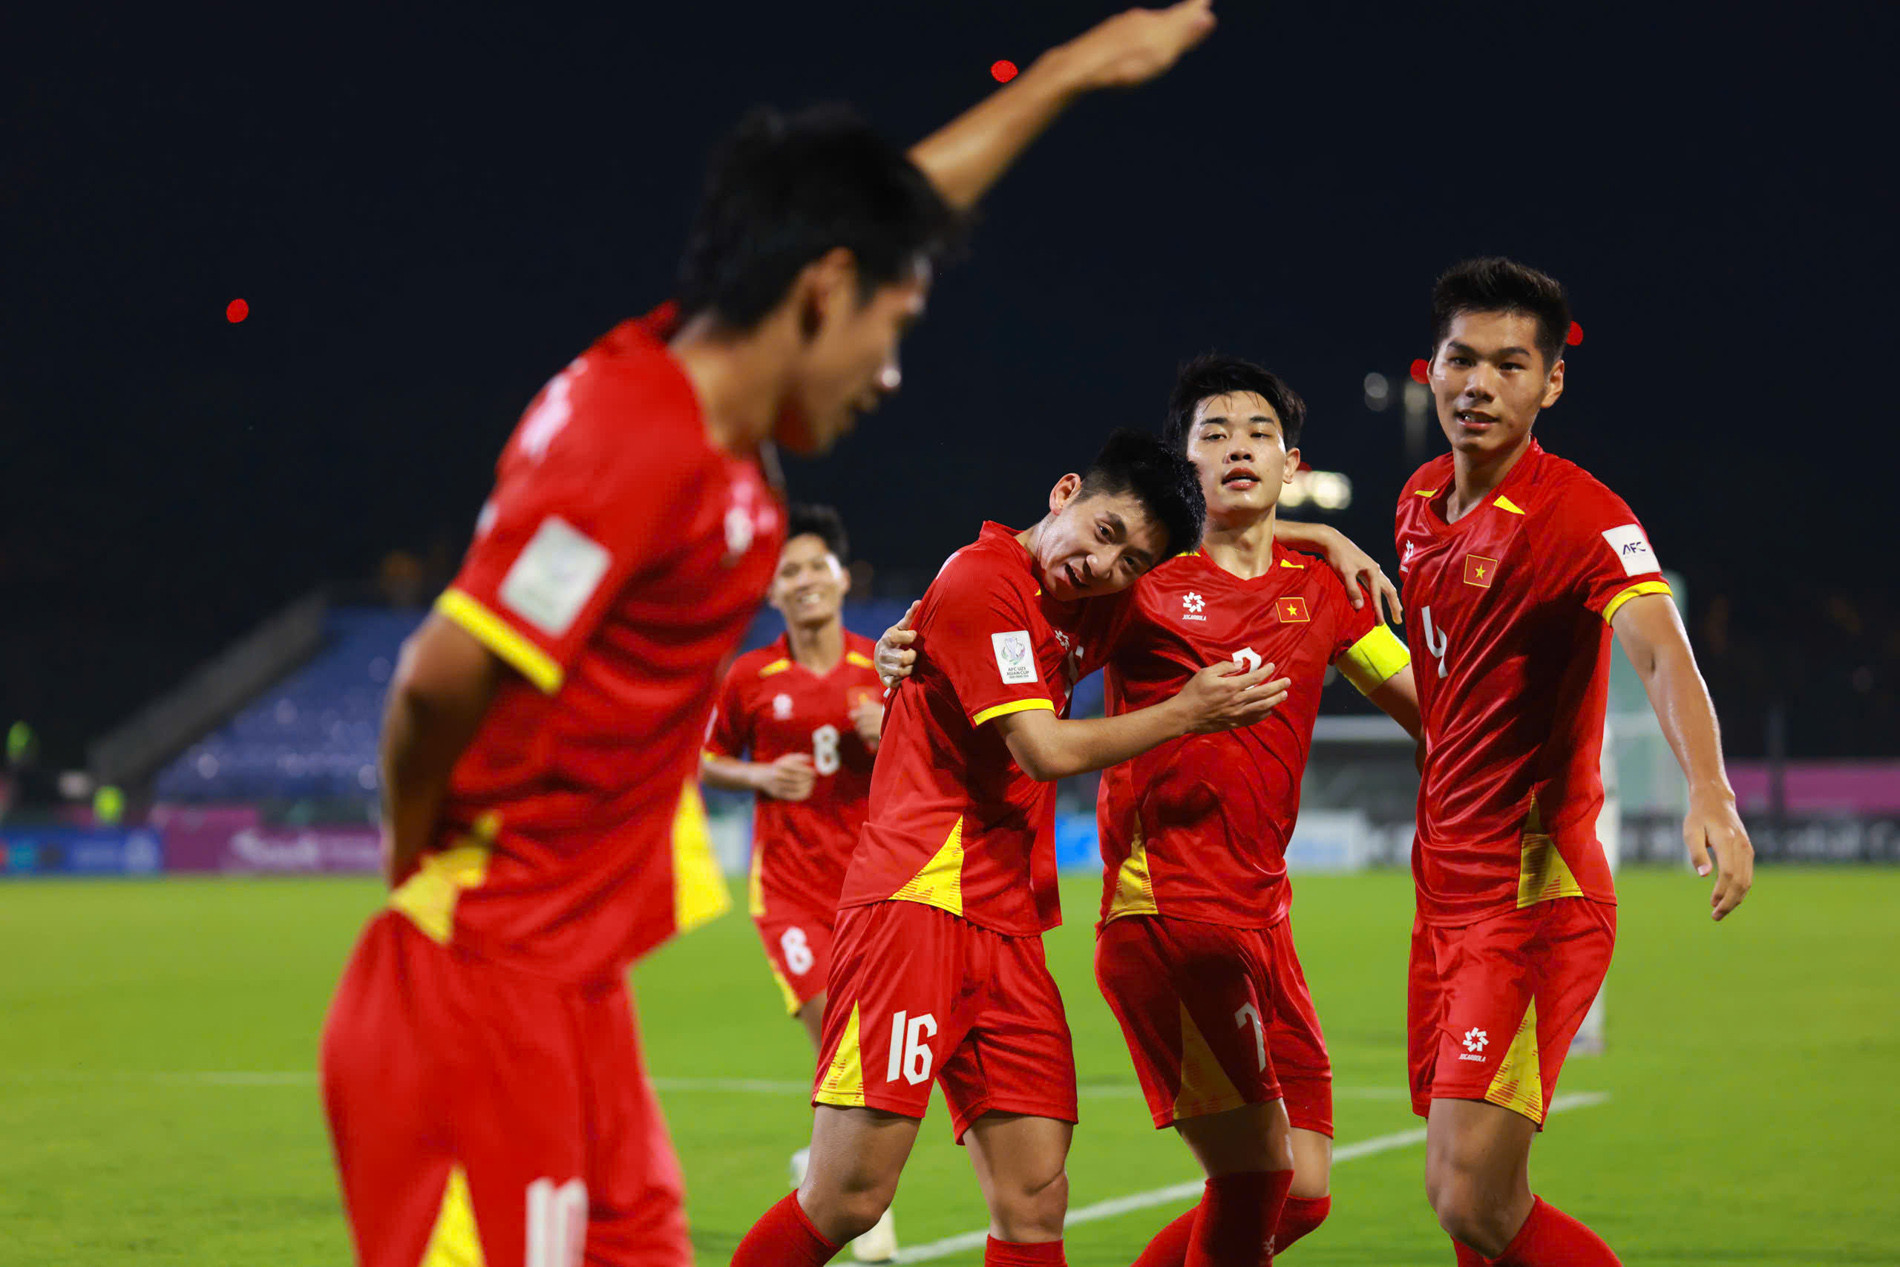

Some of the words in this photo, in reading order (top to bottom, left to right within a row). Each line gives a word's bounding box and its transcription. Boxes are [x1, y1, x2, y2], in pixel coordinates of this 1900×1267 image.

[1622, 541, 1646, 555] AFC
[1421, 605, 1449, 679] 4
[812, 723, 840, 776] 8
[781, 926, 814, 975] 8
[886, 1010, 938, 1086] 16
[1234, 1001, 1267, 1073] 7
